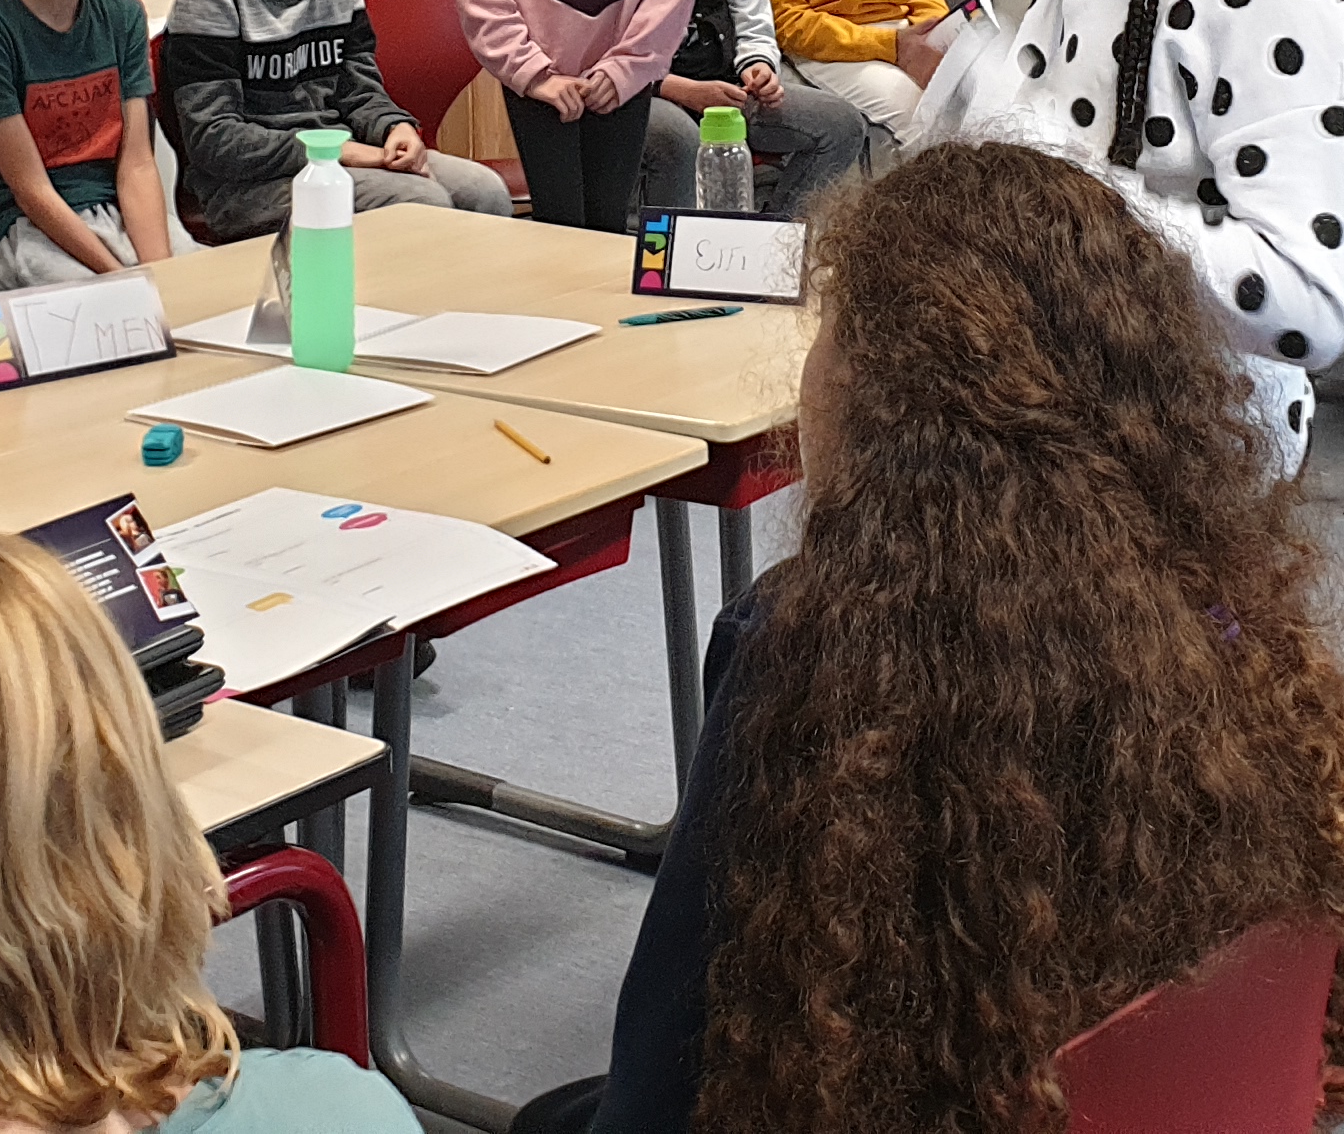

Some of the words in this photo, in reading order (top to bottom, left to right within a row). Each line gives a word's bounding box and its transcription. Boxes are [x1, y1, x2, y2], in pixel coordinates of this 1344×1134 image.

[31, 92, 70, 111] AFC
[71, 76, 115, 106] AJAX
[13, 300, 167, 373] TYMEN
